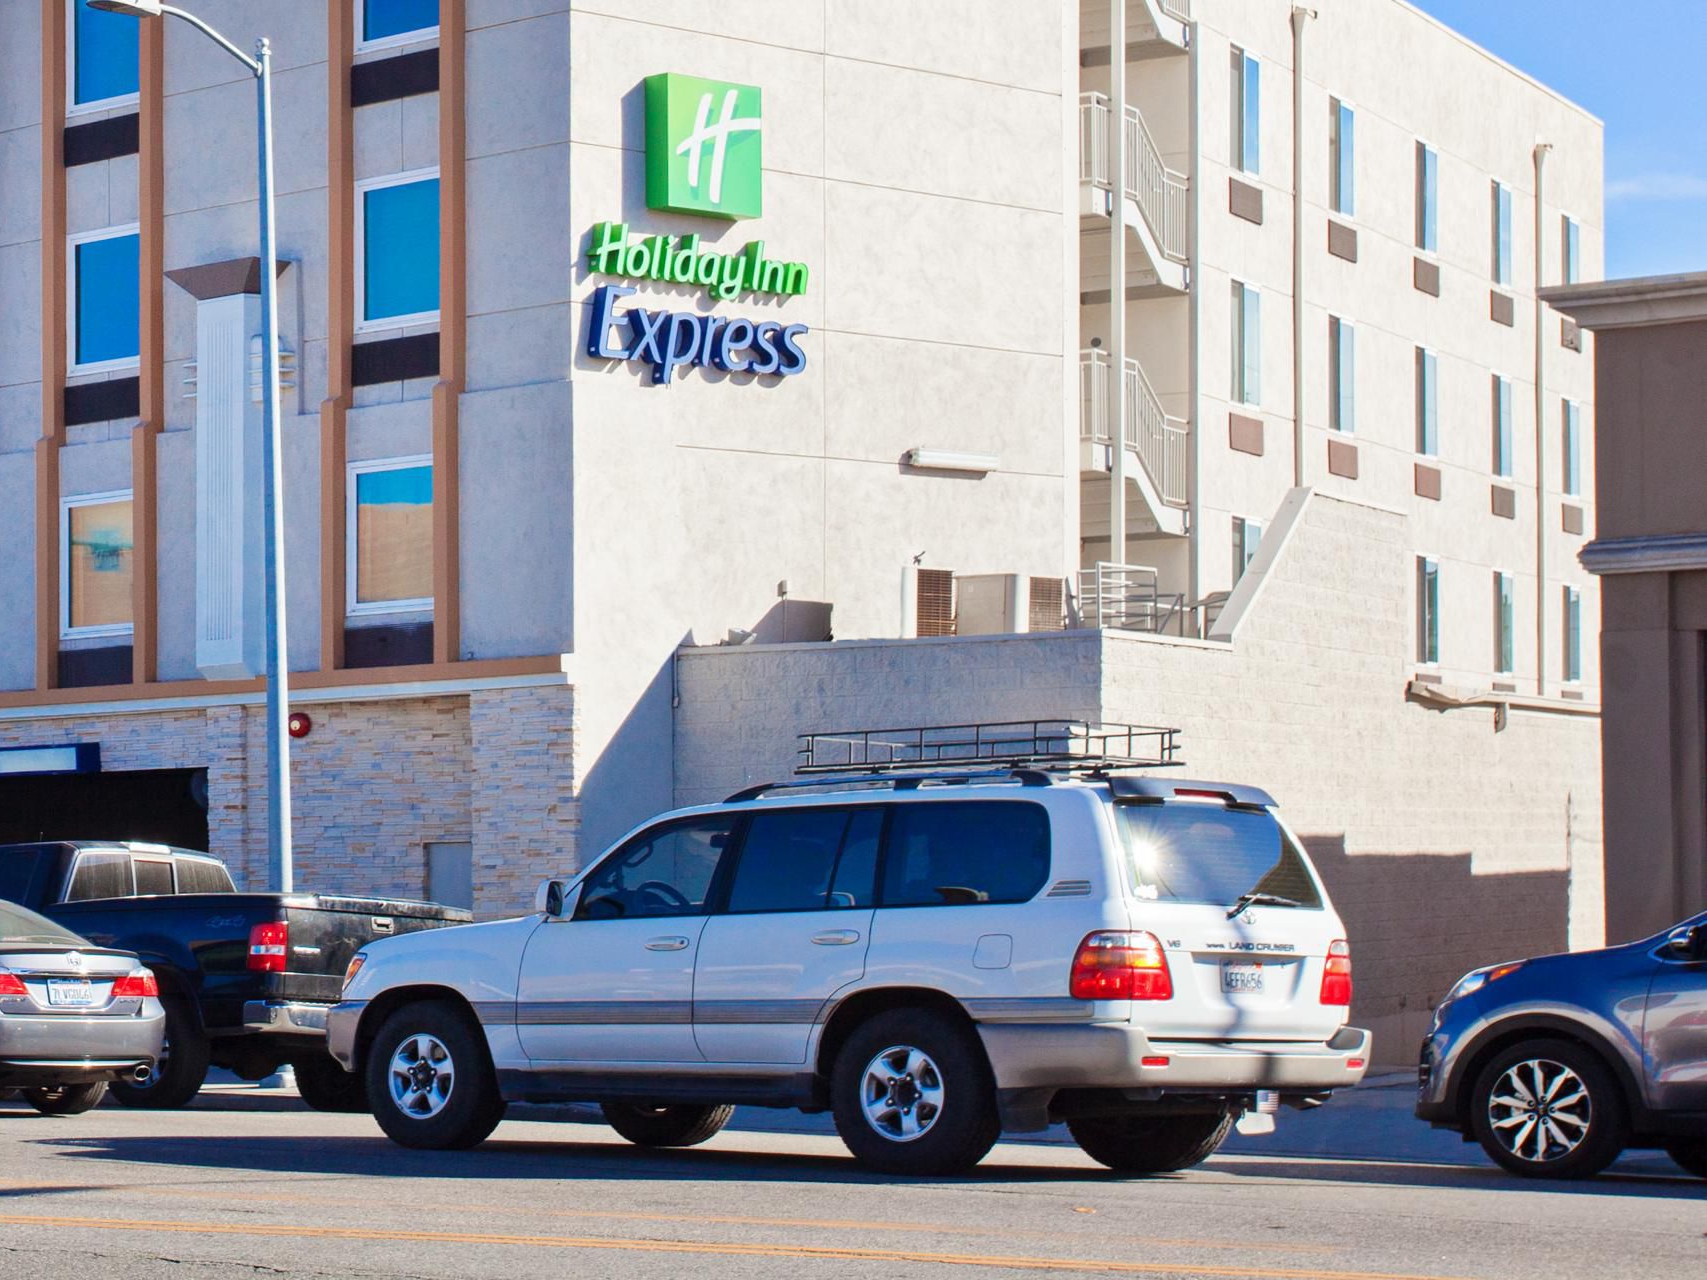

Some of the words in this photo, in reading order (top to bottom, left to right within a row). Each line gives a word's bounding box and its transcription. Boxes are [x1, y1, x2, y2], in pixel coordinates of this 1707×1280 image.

[589, 221, 746, 301] Holiday
[746, 240, 809, 296] Inn
[588, 285, 808, 385] Express
[1229, 942, 1255, 951] LAND
